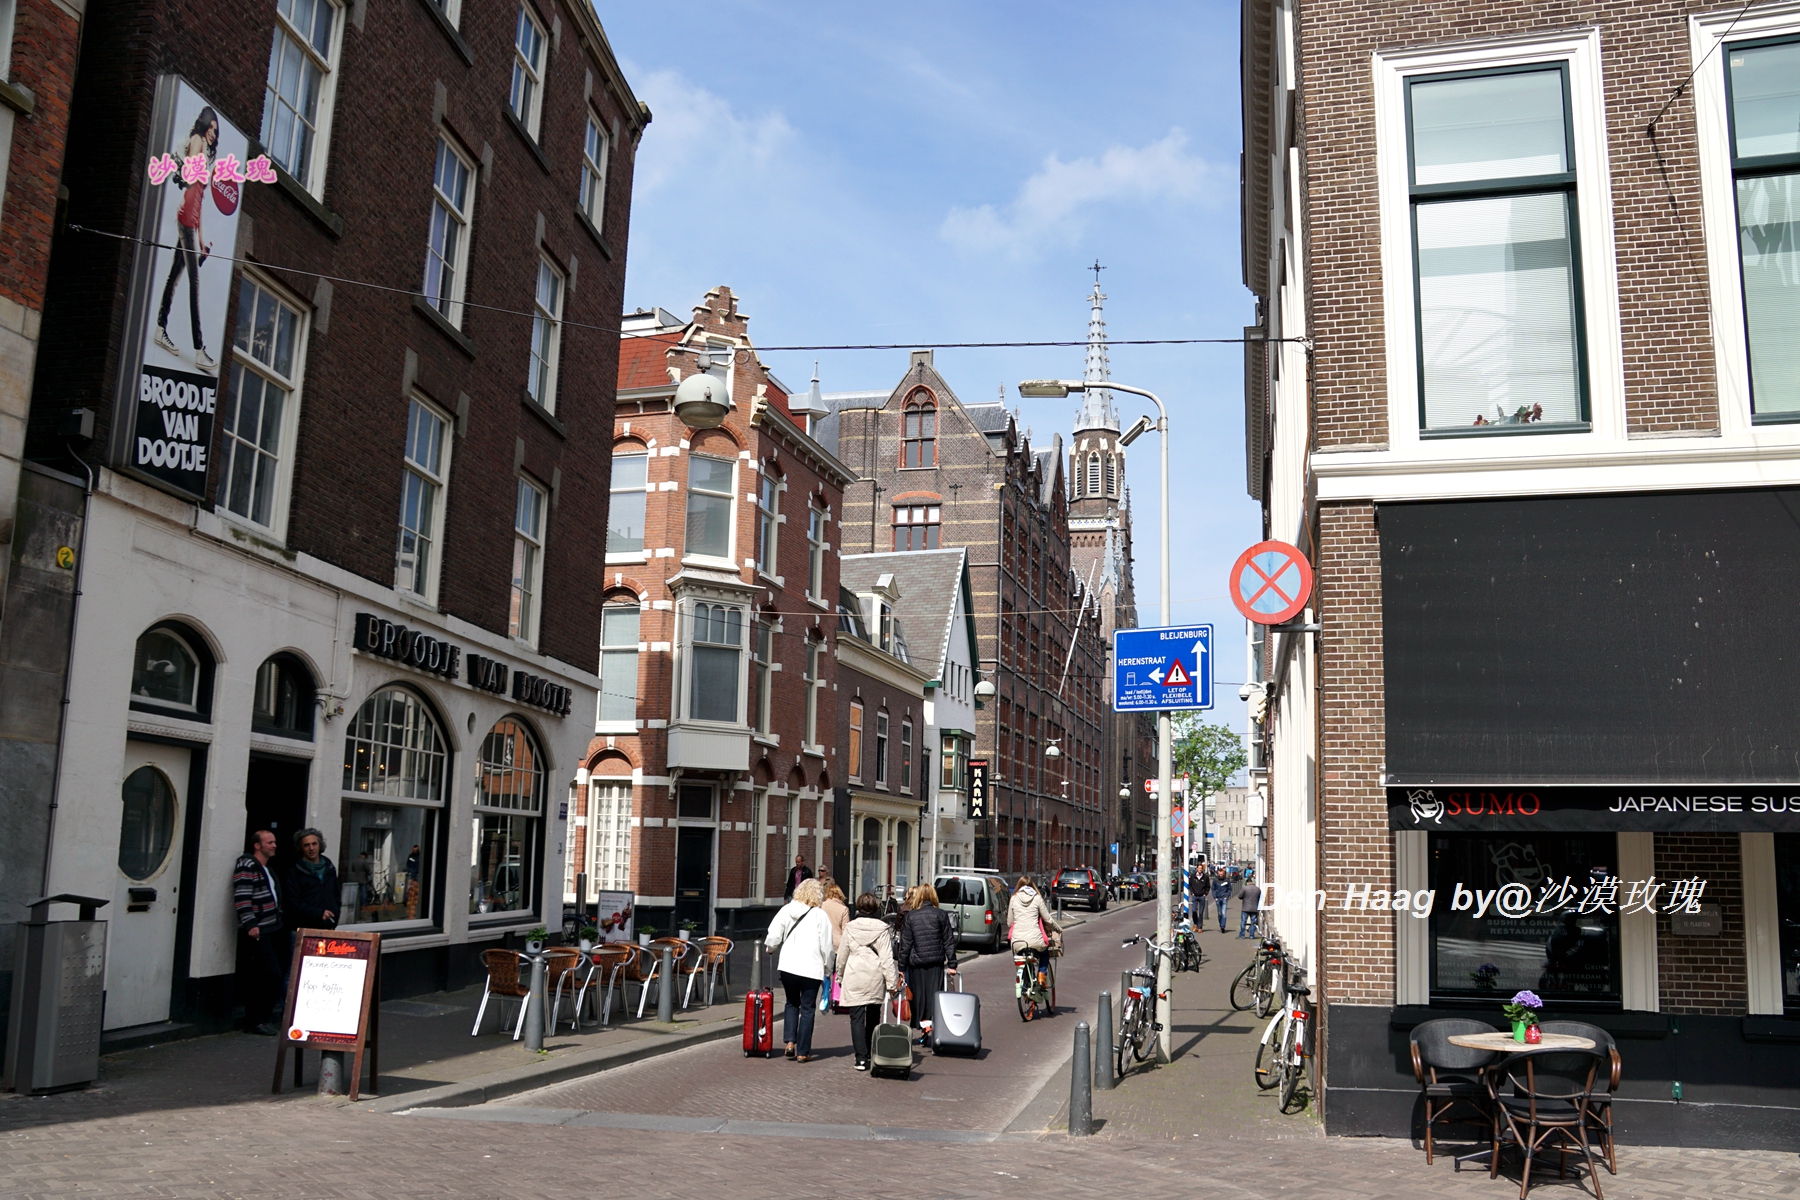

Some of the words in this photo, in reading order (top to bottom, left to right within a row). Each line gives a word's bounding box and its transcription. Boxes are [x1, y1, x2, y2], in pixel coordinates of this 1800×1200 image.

[140, 374, 216, 414] BROODJE
[162, 409, 199, 442] VAN
[138, 436, 207, 472] DOOTJE
[1160, 630, 1208, 640] BLEIJENBURG
[355, 613, 461, 679] BROODJE
[467, 654, 509, 694] VAN
[514, 671, 572, 718] DOOTJE
[1118, 656, 1166, 666] HERENSTRAAT
[972, 768, 982, 817] KARMA
[1447, 792, 1541, 816] SUMO
[1609, 796, 1743, 813] JAPANESE
[1750, 796, 1800, 813] SUS
[1557, 972, 1602, 980] ROTTERDAM
